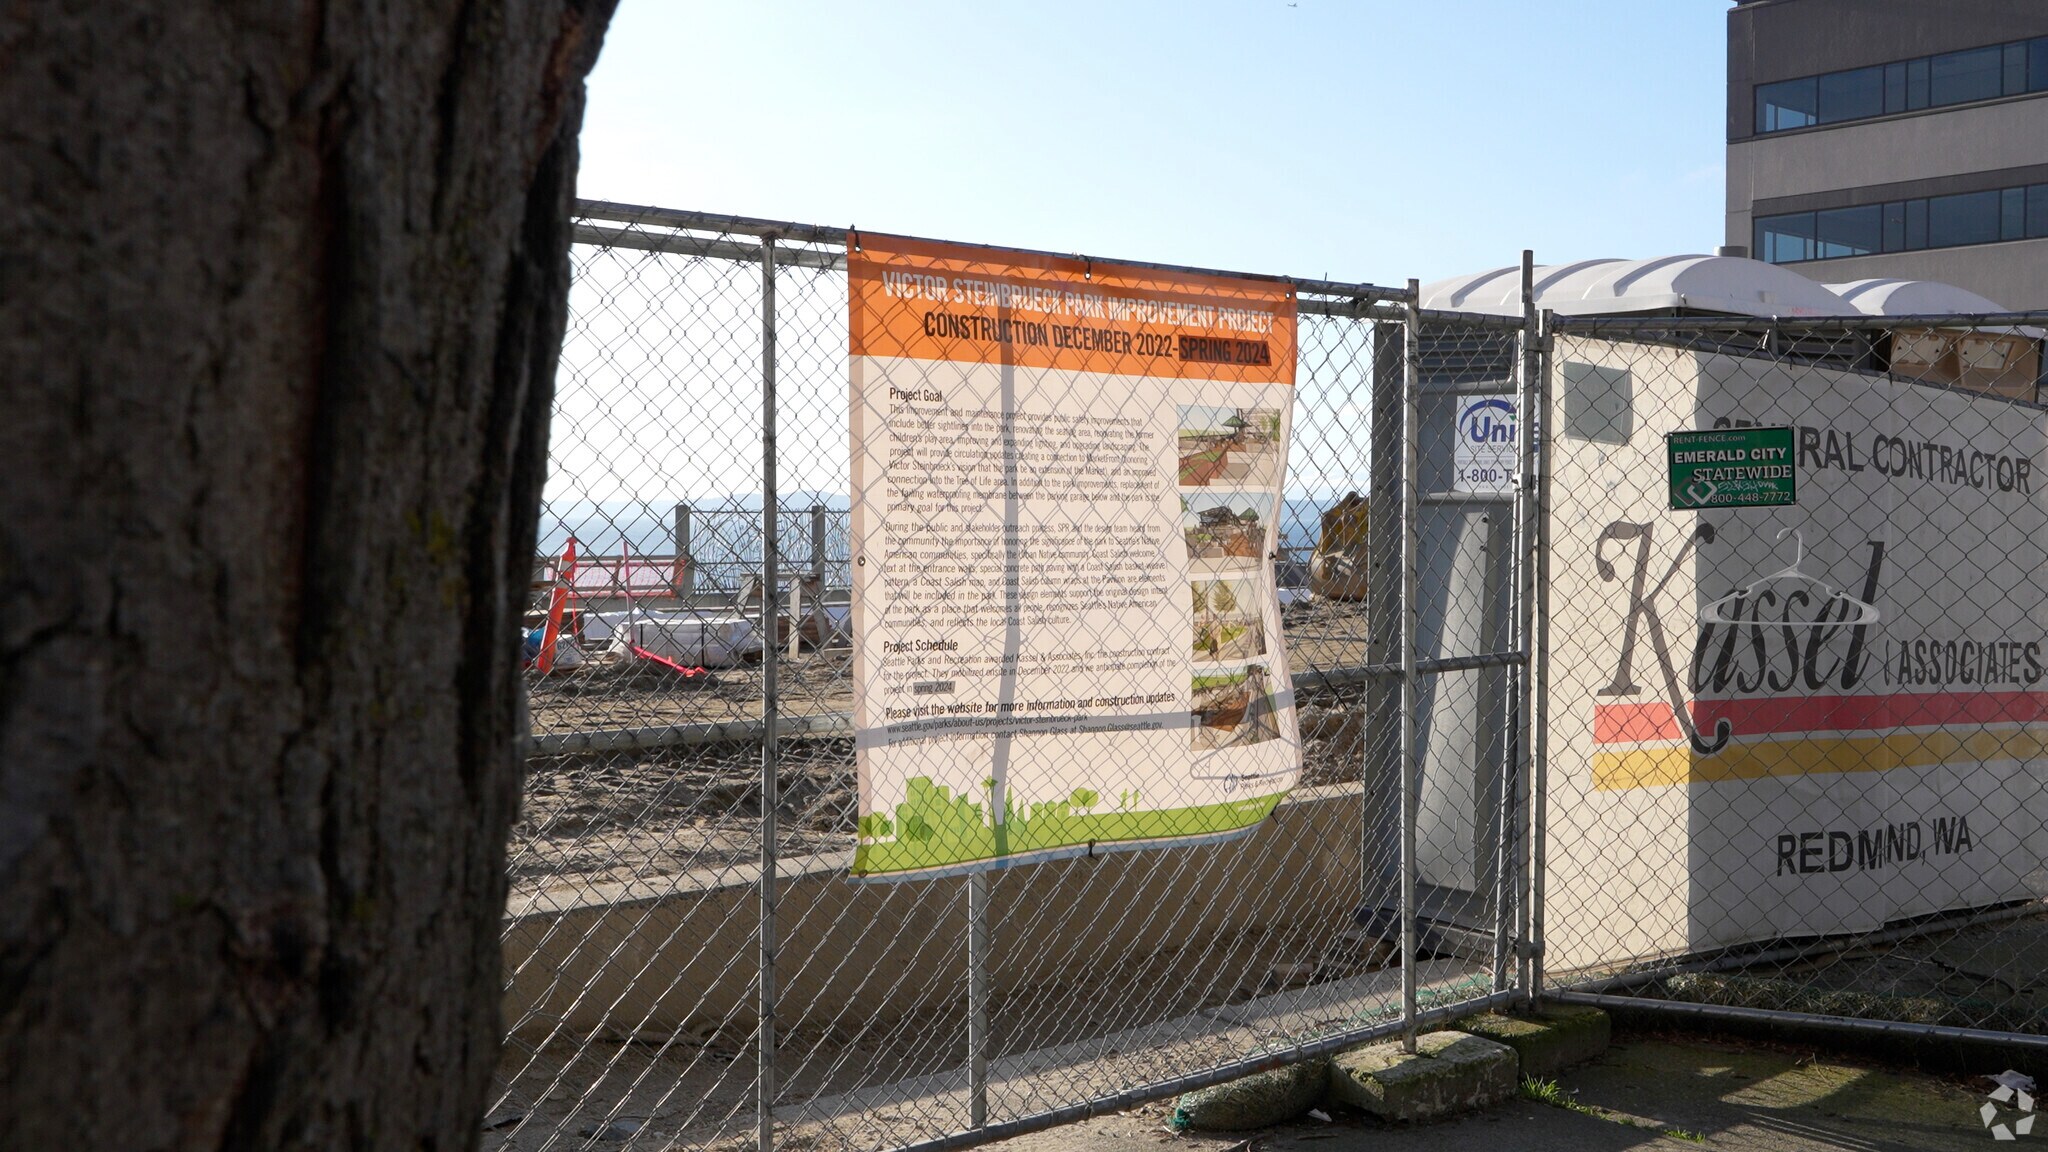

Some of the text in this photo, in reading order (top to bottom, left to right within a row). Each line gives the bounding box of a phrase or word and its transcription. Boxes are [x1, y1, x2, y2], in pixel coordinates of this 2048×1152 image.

[882, 271, 1274, 334] VICTOR STEINBRUECK PARK IMPROVEMENT PROJECT
[924, 311, 1048, 347] CONSTRUCTION
[1053, 325, 1132, 354] DECEMBER
[1236, 341, 1270, 364] 2024
[890, 387, 942, 402] Project Goal
[890, 404, 904, 414] This
[906, 405, 948, 418] improvement
[950, 408, 963, 417] and
[965, 409, 1003, 419] maintenance
[889, 419, 915, 429] include
[984, 423, 995, 432] the
[1045, 426, 1054, 435] the
[916, 447, 928, 456] will
[1674, 447, 1787, 464] EMERALD CITY
[888, 460, 909, 470] Victor
[1872, 434, 2031, 494] CONTRACTOR
[944, 475, 954, 485] the
[979, 476, 992, 486] Life
[1693, 465, 1792, 482] STATEWIDE
[887, 488, 898, 498] the
[1711, 492, 1790, 503] 800-448-7772
[950, 523, 962, 532] and
[913, 590, 922, 600] be
[967, 590, 979, 600] the
[930, 618, 944, 627] and
[976, 617, 988, 626] the
[1595, 521, 2041, 755] Kassel ASSOCIATES
[883, 639, 958, 655] Project Schedule
[928, 655, 941, 665] and
[886, 691, 1175, 719] Please visit the website for more information and construction updates
[1933, 816, 1973, 855] WA
